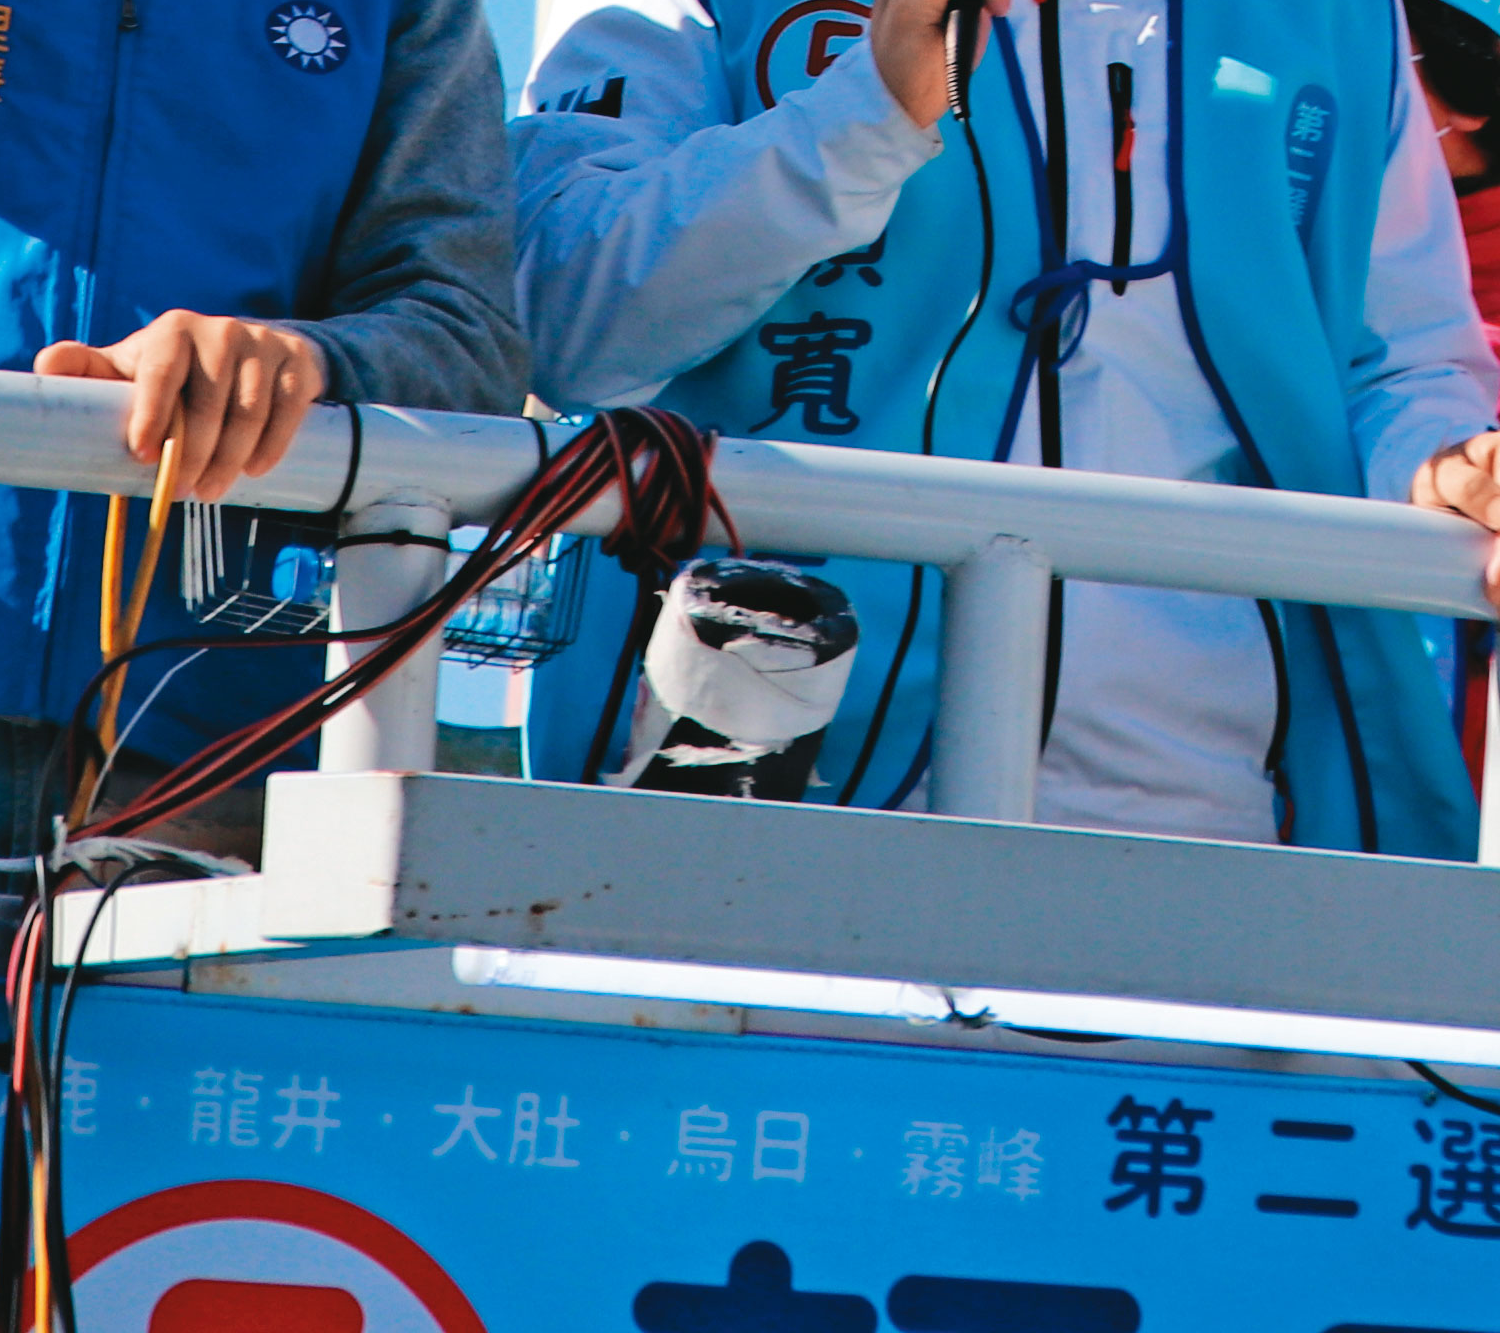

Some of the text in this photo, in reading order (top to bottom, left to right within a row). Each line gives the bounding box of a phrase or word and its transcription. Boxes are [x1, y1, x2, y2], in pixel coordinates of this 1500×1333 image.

[190, 1065, 341, 1153] 龍井
[432, 1085, 581, 1168] 大肚
[902, 1121, 1045, 1200] 霧峰
